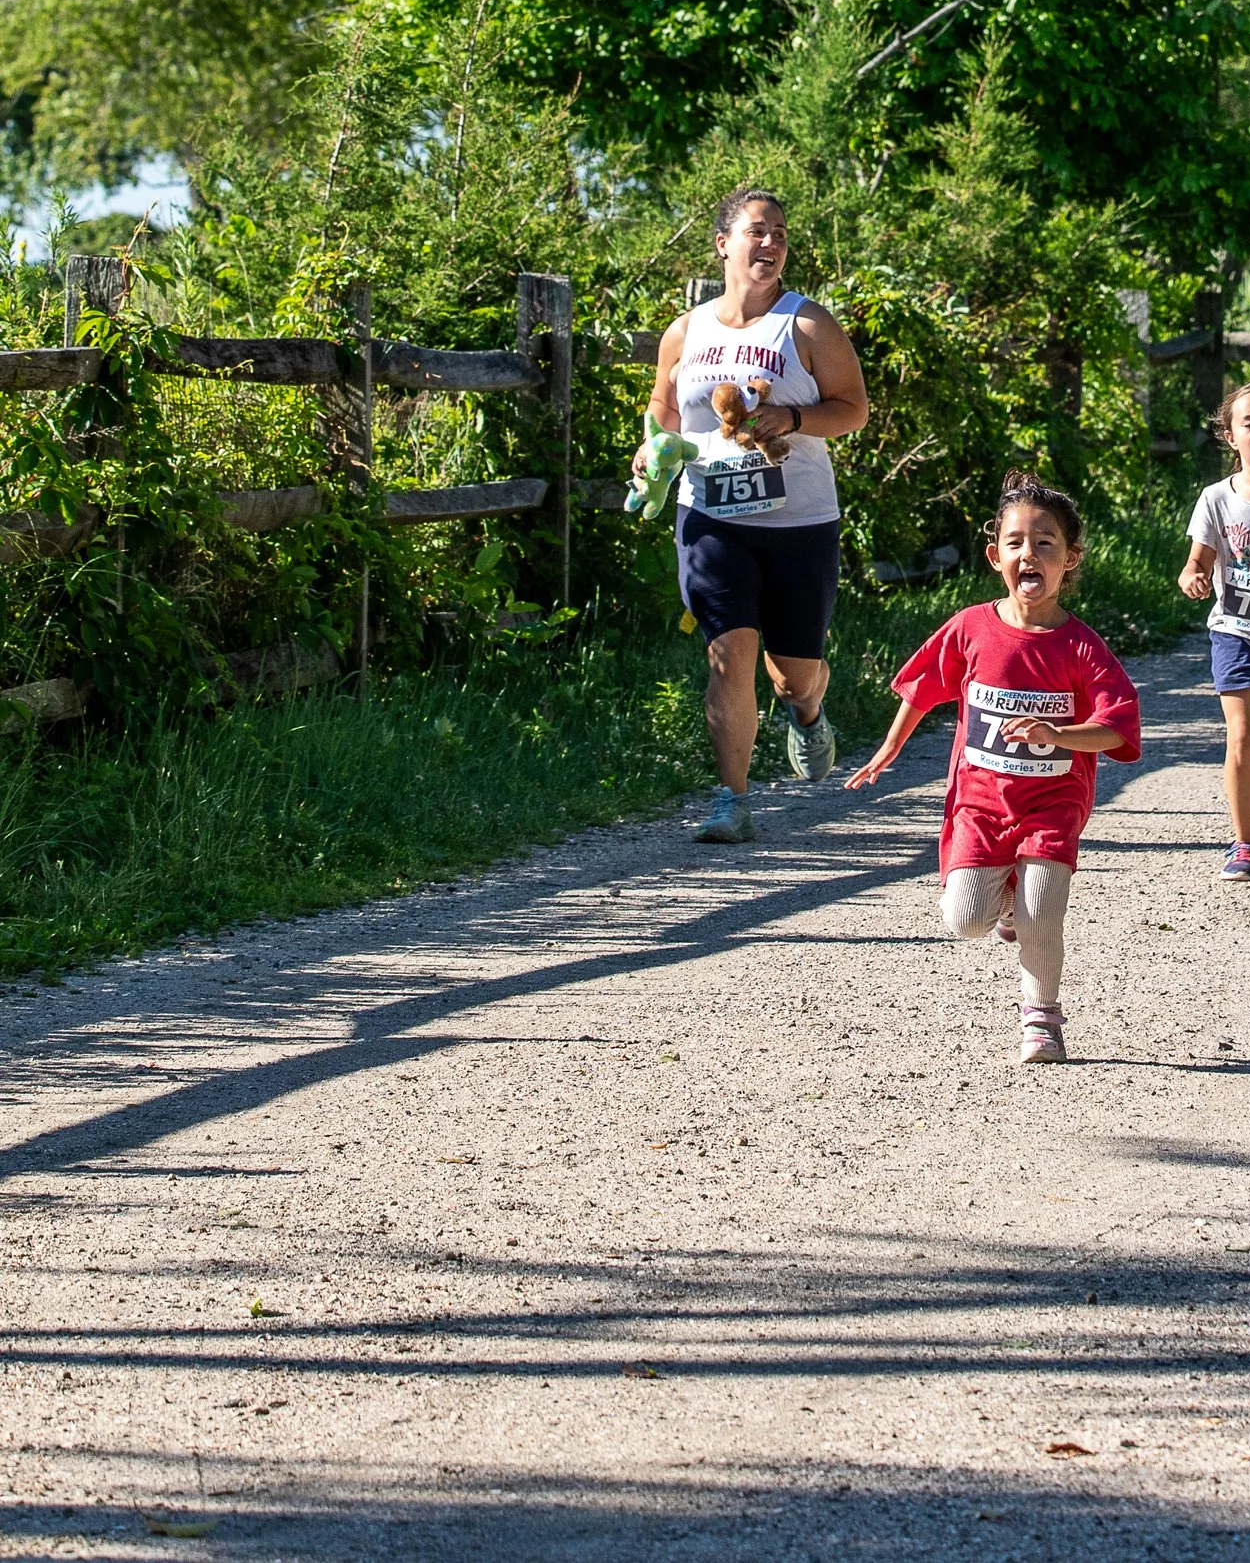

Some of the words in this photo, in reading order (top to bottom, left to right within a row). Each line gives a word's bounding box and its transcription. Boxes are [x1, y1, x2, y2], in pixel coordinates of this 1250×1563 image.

[735, 345, 786, 378] FAMILY
[721, 456, 770, 472] RUNNER
[715, 472, 766, 503] 751
[717, 507, 733, 515] Race
[734, 504, 757, 513] Series
[997, 690, 1048, 701] GREENWICH
[1048, 693, 1069, 701] ROAD
[995, 697, 1069, 714] RUNNERS
[980, 754, 1000, 768] Race
[1003, 759, 1034, 772] Series
[1036, 763, 1054, 772] '24
